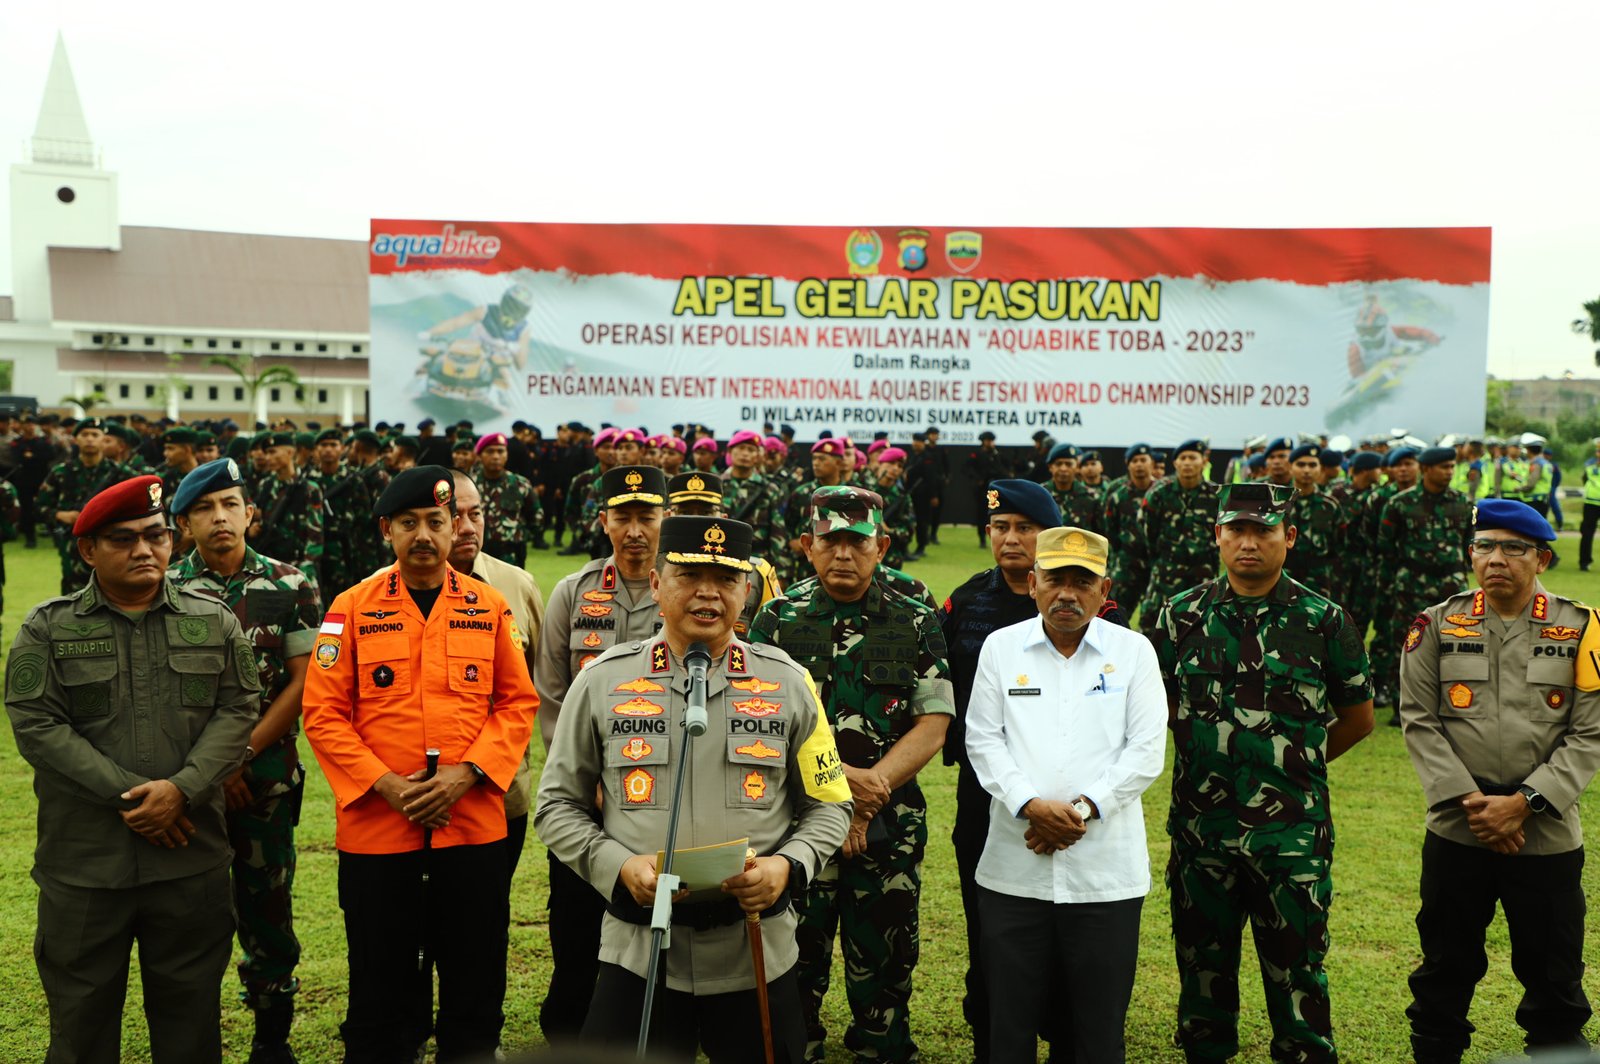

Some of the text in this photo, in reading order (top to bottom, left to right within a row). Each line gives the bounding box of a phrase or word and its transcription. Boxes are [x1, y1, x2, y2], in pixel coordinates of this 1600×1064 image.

[371, 224, 501, 267] aquabike
[672, 276, 1161, 321] APEL GELAR PASUKAN
[581, 323, 674, 345] OPERASI
[681, 324, 809, 347] KEPOLISIAN
[816, 326, 970, 349] KEWILAYAHAN
[1107, 329, 1166, 351] TOBA
[853, 354, 971, 374] Dalam Rangka
[527, 374, 1310, 407] PENGAMANAN EVENT INTERNATIONAL AQUABIKE JETSKI WORLD CHAMPIONSHIP 2023
[741, 406, 1082, 426] DI WILAYAH PROVINSI SUMATERA UTARA
[359, 622, 404, 636] BUDIONO
[449, 619, 493, 632] BASARNAS
[574, 617, 616, 630] JAWARI
[611, 719, 666, 735] AGUNG
[731, 719, 785, 736] POLRI
